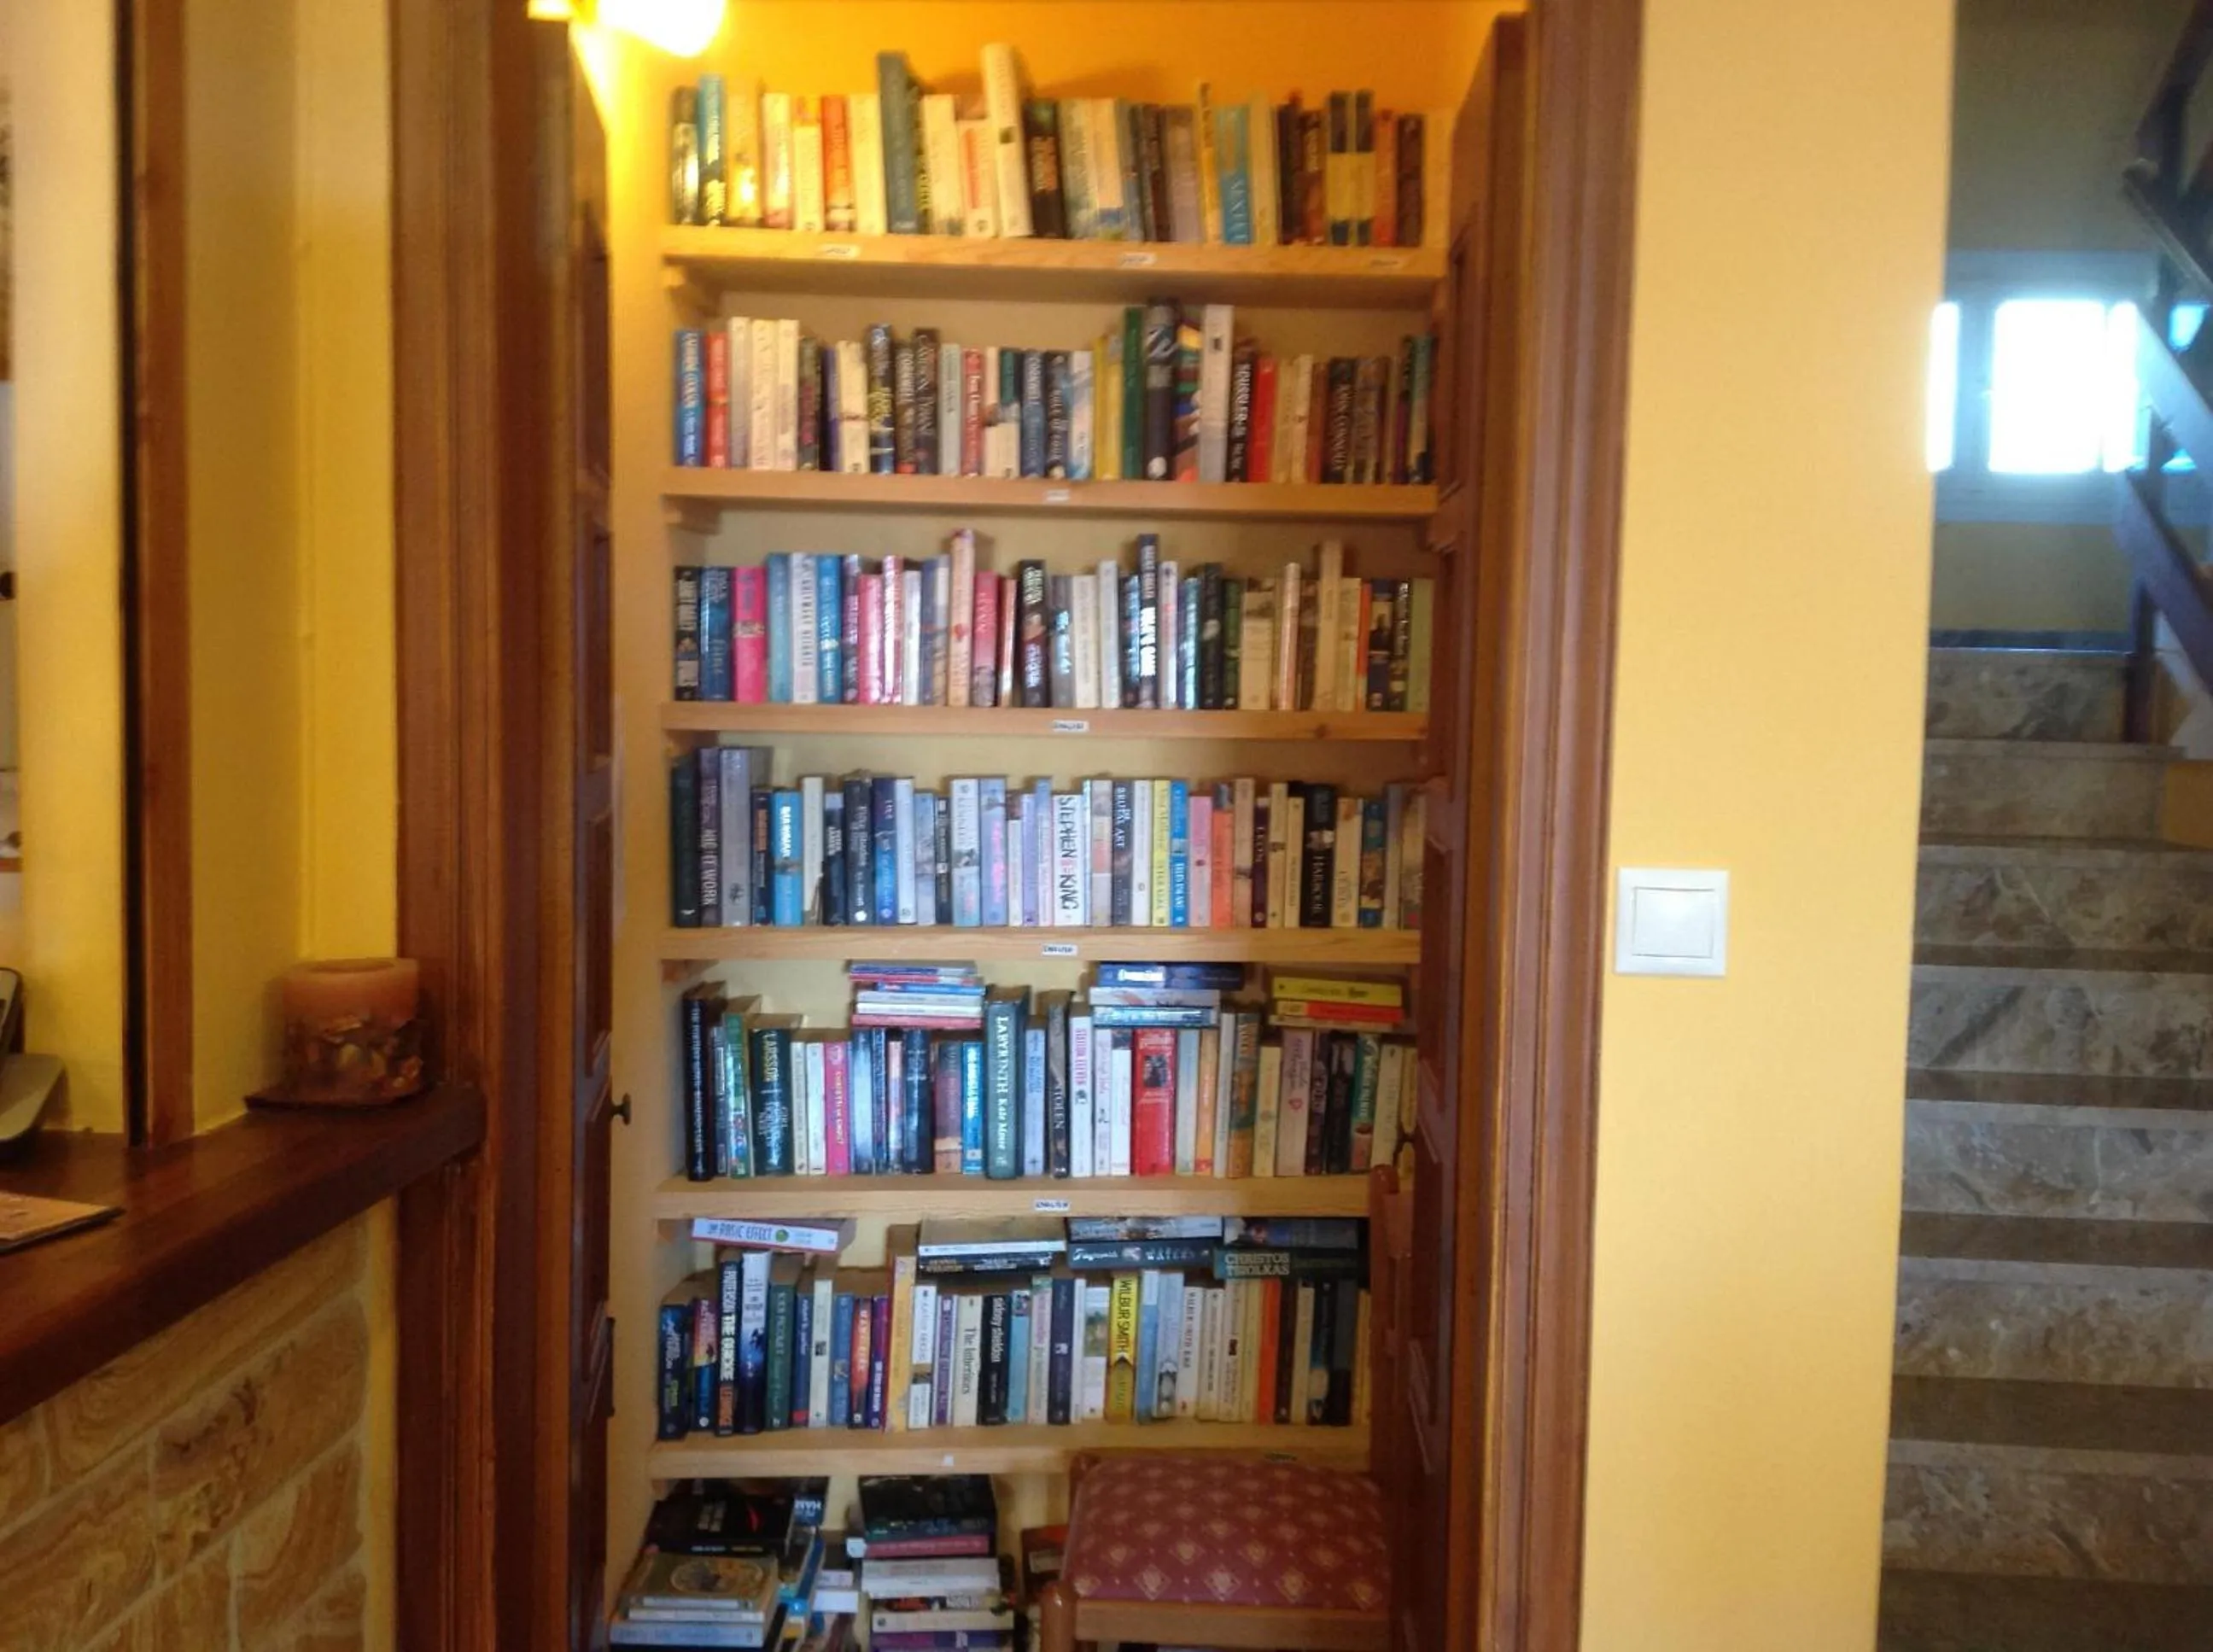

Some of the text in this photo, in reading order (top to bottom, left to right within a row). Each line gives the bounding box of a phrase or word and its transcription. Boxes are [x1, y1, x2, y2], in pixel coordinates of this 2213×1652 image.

[1113, 786, 1126, 849] BRUTAL ART
[1059, 797, 1080, 910] STEPHEN KING
[700, 867, 719, 906] WORK
[762, 1031, 779, 1082] LARSSON
[996, 1016, 1010, 1150] LABYRINTH Kate Mosse
[744, 1225, 773, 1241] EFFECT
[1224, 1252, 1290, 1265] CHRISTOS
[721, 1269, 737, 1313] PATTERSON
[721, 1314, 736, 1336] THE
[963, 1326, 977, 1346] The
[990, 1296, 1007, 1363] sidney sheldon
[1115, 1279, 1133, 1353] WILBUR SMITH
